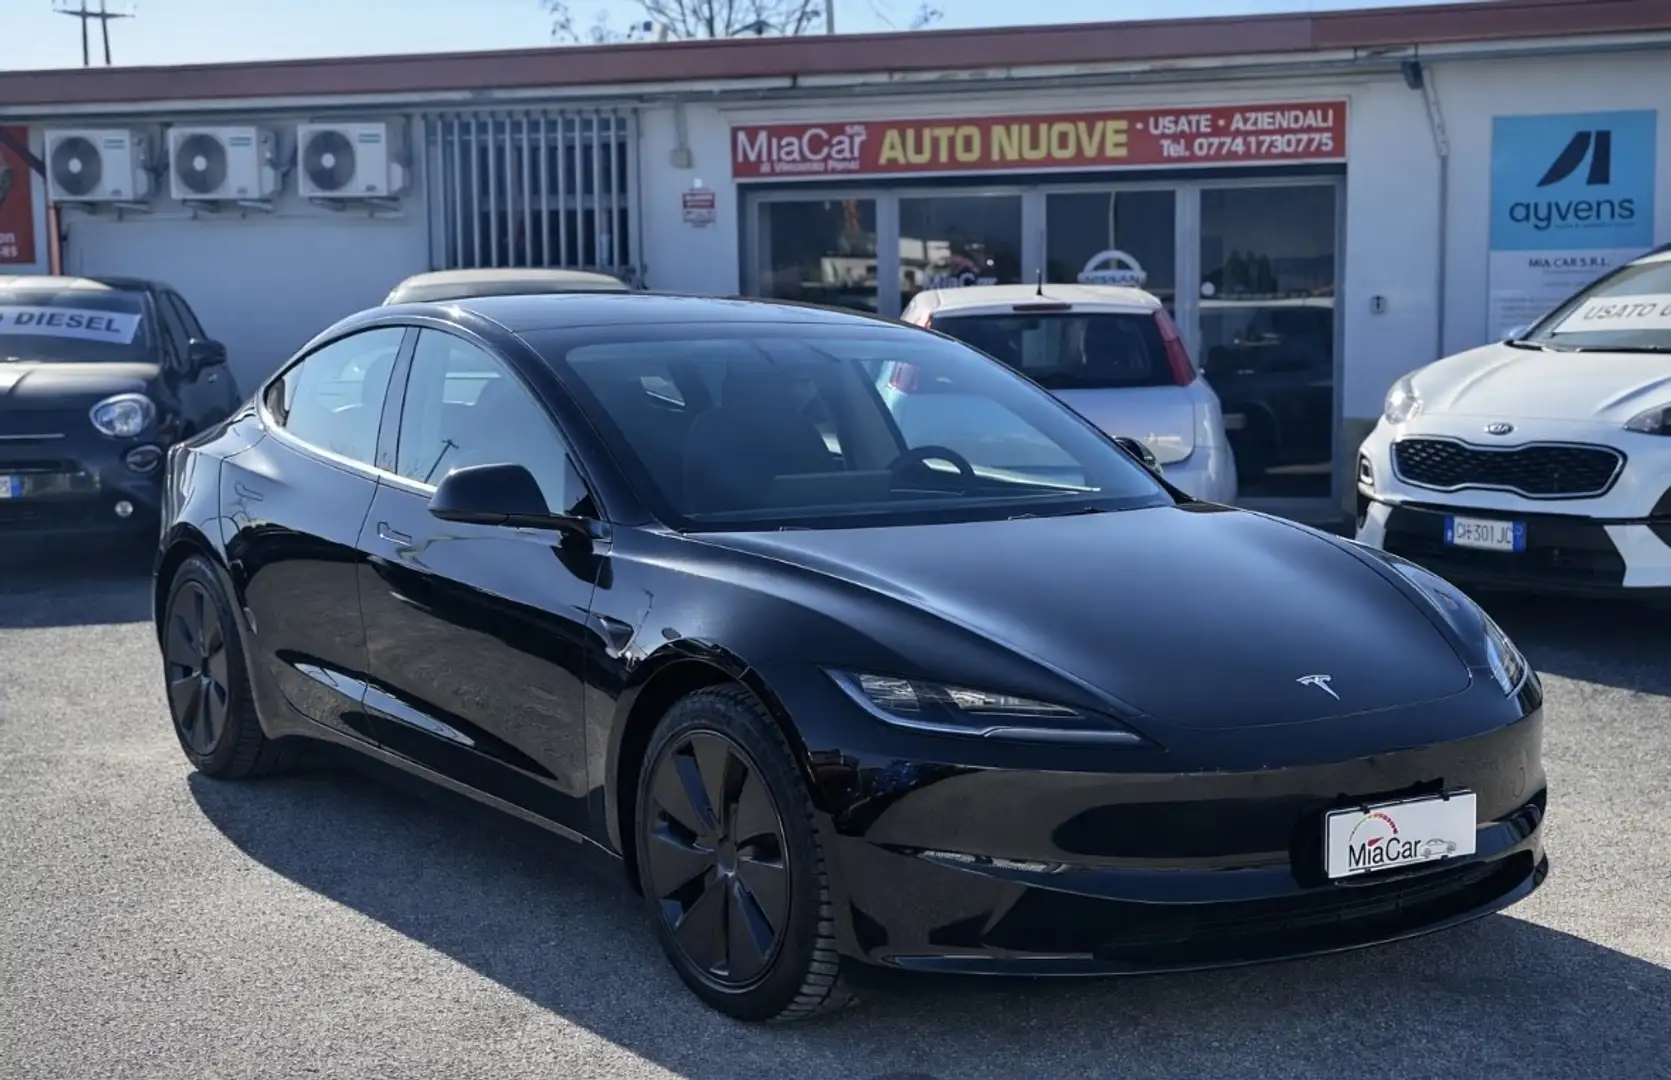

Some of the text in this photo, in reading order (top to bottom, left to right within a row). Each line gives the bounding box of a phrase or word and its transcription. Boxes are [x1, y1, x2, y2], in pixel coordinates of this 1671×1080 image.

[1148, 108, 1334, 135] USATE AZIENDALI
[736, 127, 867, 163] MiaCar
[878, 120, 1129, 165] AUTO NUOVE
[1159, 133, 1334, 157] Tel. 07741730775
[1509, 197, 1636, 230] ayvens
[1528, 257, 1551, 267] MIA
[14, 311, 121, 333] DIESEL
[1582, 303, 1658, 319] USATO
[1348, 837, 1421, 868] MiaCar
